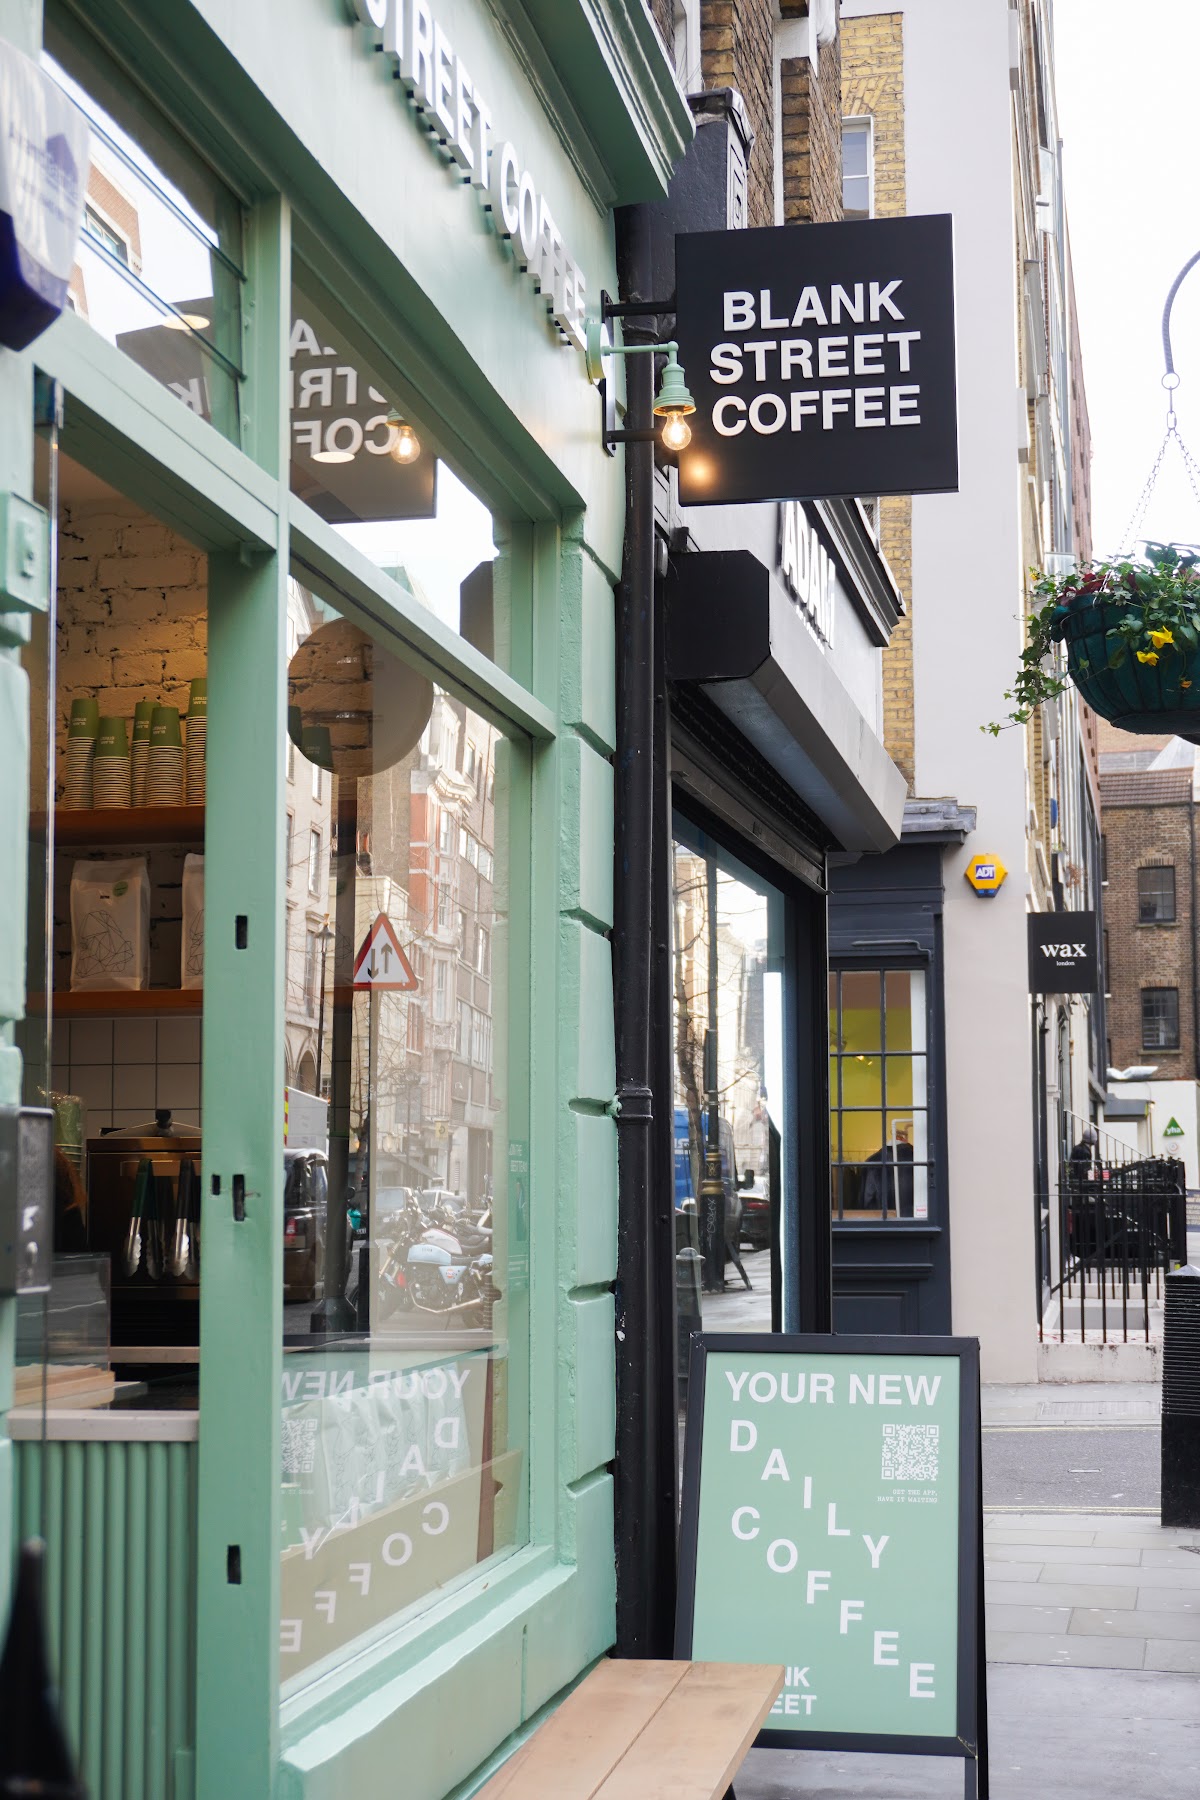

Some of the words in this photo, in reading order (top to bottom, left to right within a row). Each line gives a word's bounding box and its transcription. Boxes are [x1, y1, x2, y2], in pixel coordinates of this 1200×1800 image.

[356, 0, 492, 190] TREET
[491, 140, 588, 351] COFFEE
[723, 279, 905, 332] BLANK
[709, 331, 921, 385] STREET
[712, 384, 921, 436] COFFEE
[976, 866, 994, 878] ADT
[1040, 943, 1087, 957] wax
[1167, 1126, 1182, 1136] yha
[725, 1371, 835, 1404] YOUR
[848, 1373, 942, 1406] NEW
[730, 1420, 890, 1568] DAILY
[731, 1506, 936, 1698] COFFEE
